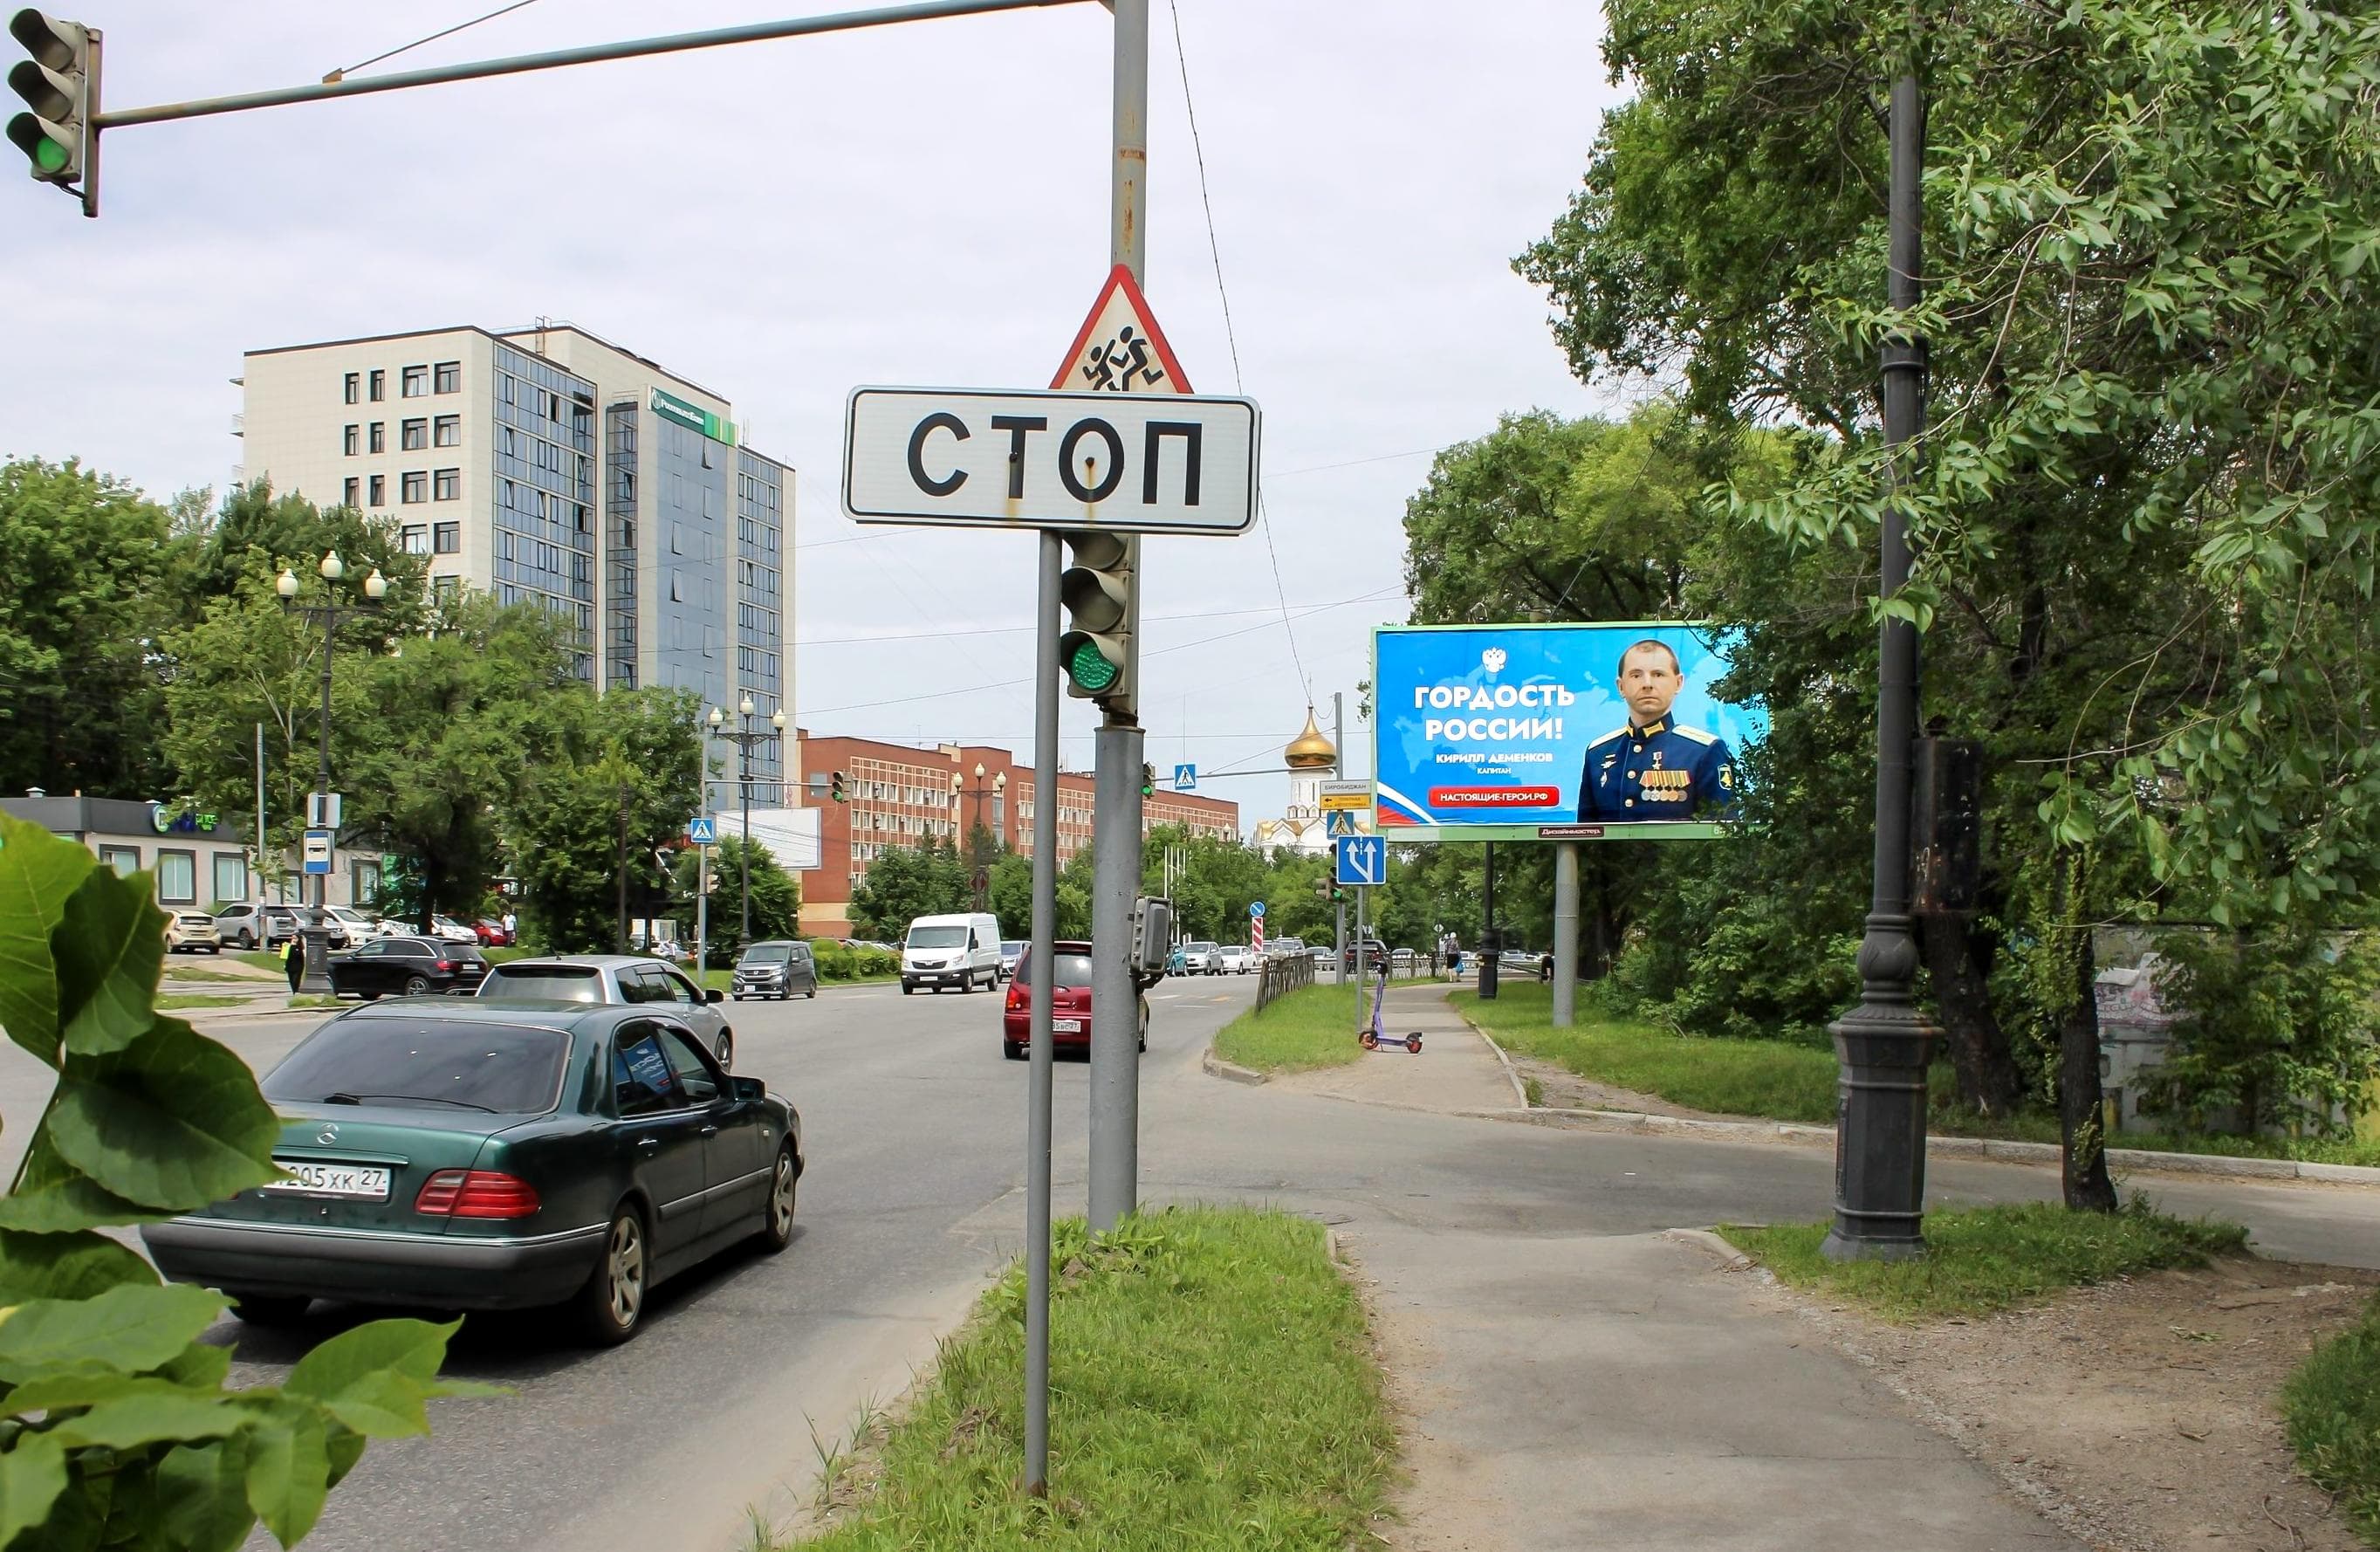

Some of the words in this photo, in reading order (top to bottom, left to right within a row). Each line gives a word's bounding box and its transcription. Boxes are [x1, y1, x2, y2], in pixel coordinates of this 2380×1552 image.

[908, 412, 1202, 505] СТОП
[1414, 684, 1575, 711] ГОРДОСТЬ
[1424, 718, 1564, 741] РОССИИ!
[1436, 753, 1485, 764] КИРИЛЛ
[1488, 752, 1554, 764] ДЕМЕНКОВ
